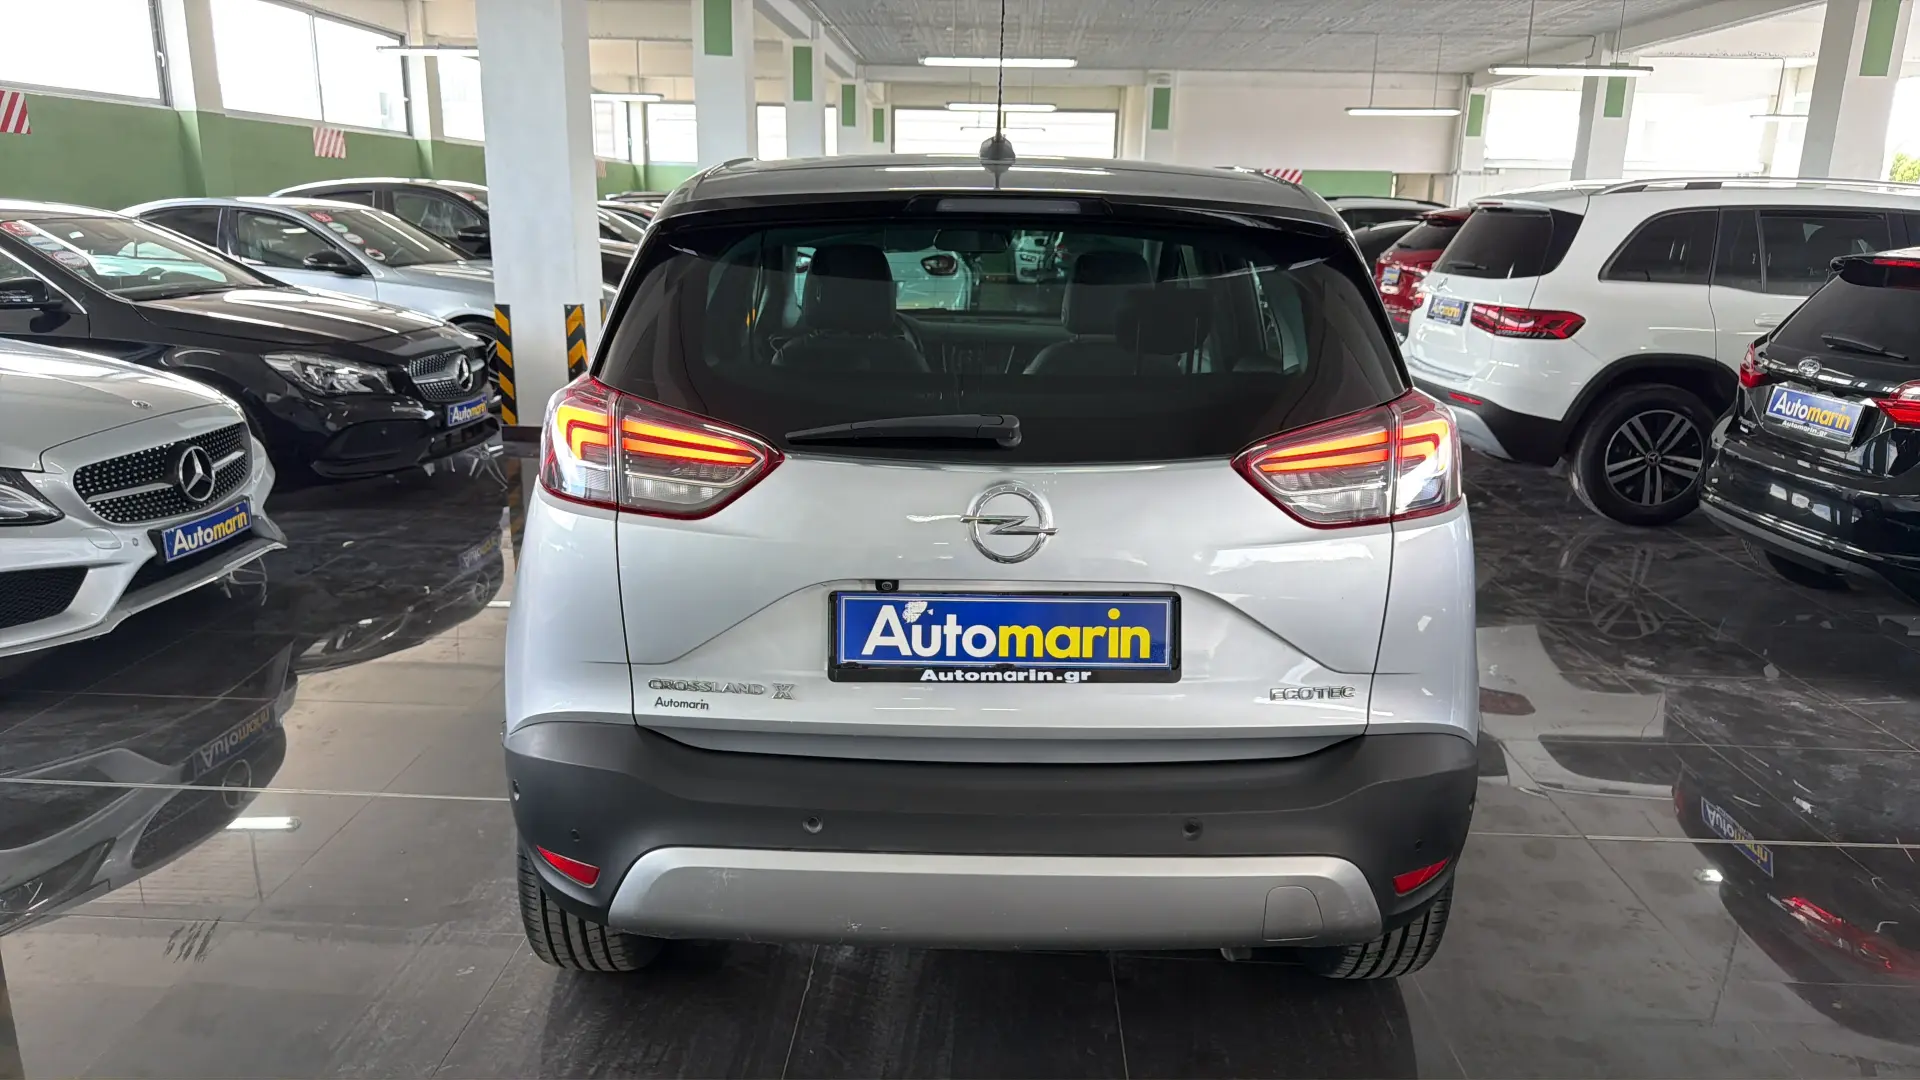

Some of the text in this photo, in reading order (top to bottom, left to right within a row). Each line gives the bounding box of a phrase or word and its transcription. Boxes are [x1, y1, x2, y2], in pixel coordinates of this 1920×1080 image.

[1773, 391, 1851, 431] Automarin
[1781, 420, 1828, 437] Automarin.gr
[173, 506, 248, 555] Automarin
[861, 604, 1151, 659] Automarin
[920, 669, 1092, 683] Automarin.gr
[648, 678, 797, 700] CROSSLAND X
[1270, 685, 1356, 701] ECOTEC
[654, 697, 709, 710] Automarin
